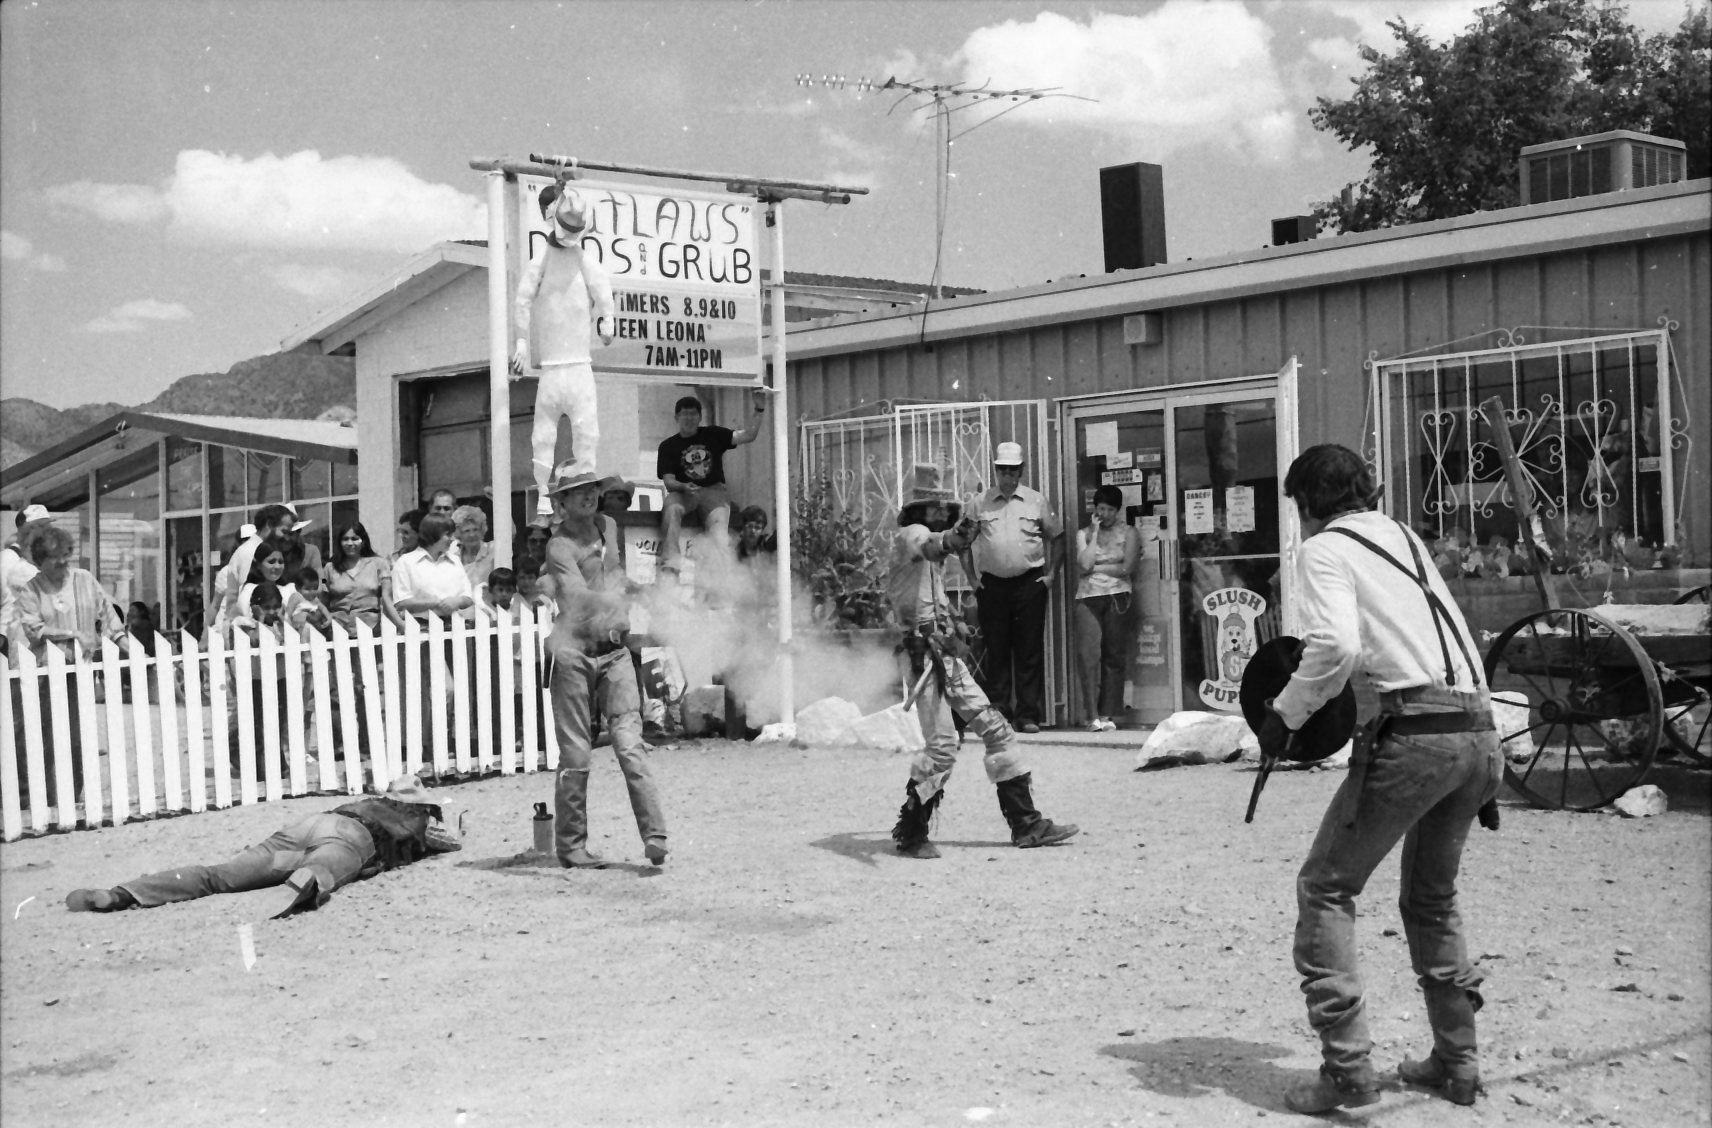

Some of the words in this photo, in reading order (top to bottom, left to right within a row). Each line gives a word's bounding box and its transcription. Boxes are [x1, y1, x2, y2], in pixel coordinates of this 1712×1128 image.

[528, 184, 750, 245] "TLAWS"
[597, 316, 648, 340] EEN
[645, 345, 722, 369] 7AM-11PM
[1206, 589, 1262, 612] SLUSH
